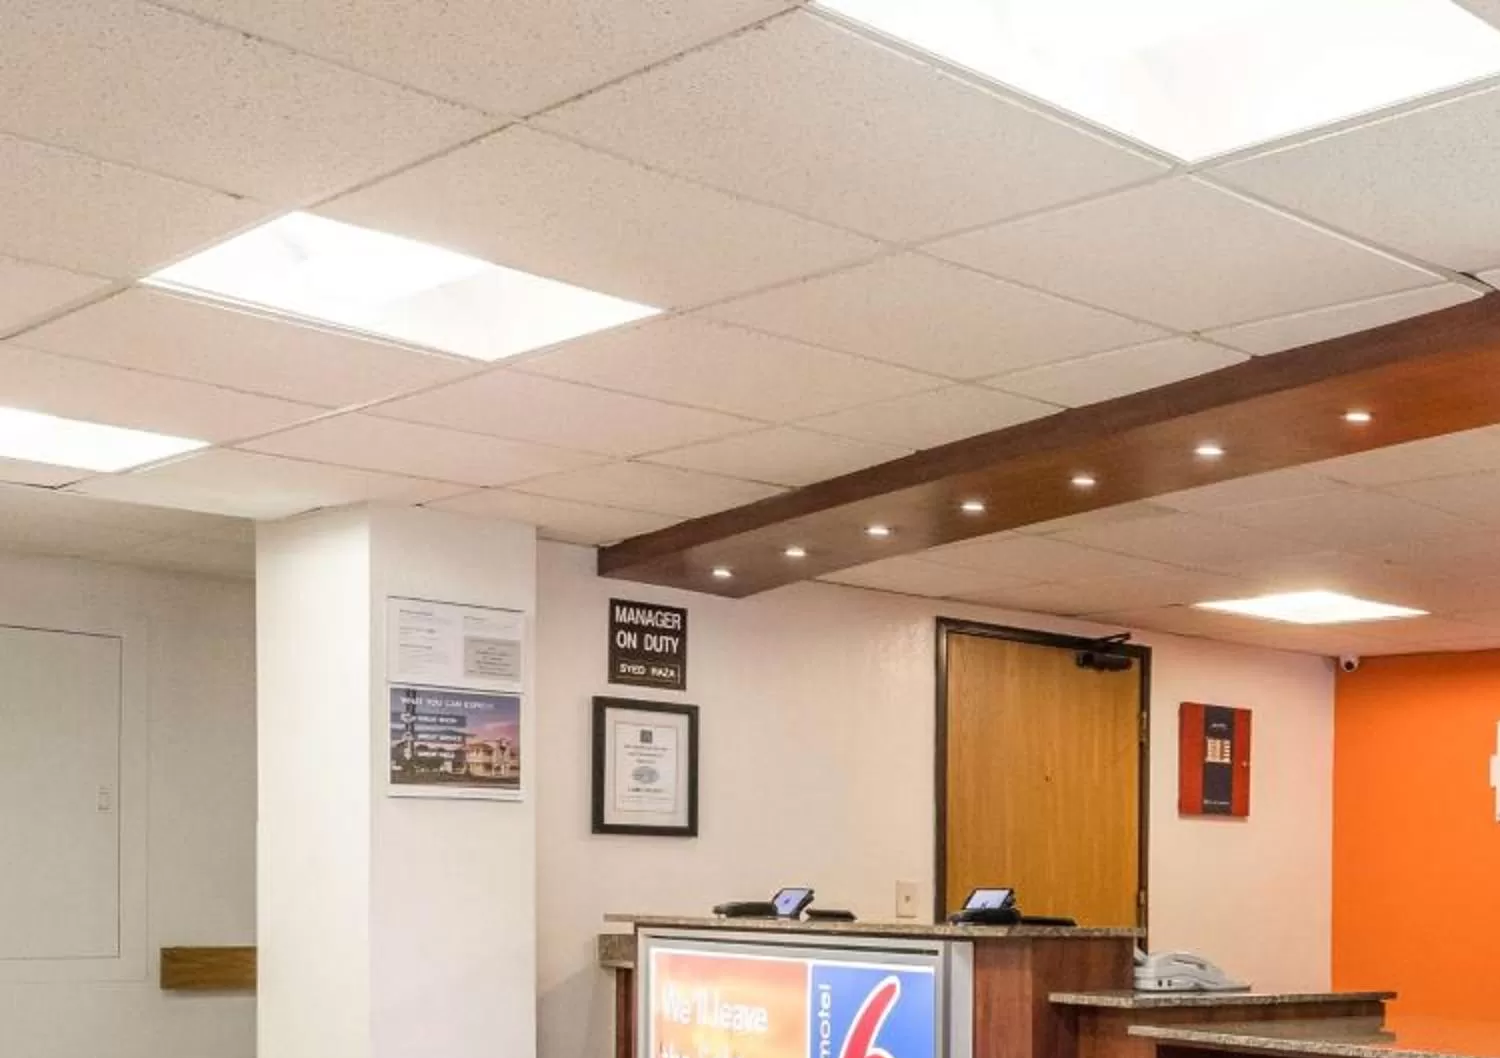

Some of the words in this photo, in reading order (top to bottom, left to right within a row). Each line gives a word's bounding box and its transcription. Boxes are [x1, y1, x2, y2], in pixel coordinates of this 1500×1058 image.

[615, 604, 682, 631] MANAGER
[616, 629, 638, 649] ON
[643, 633, 680, 654] DUTY
